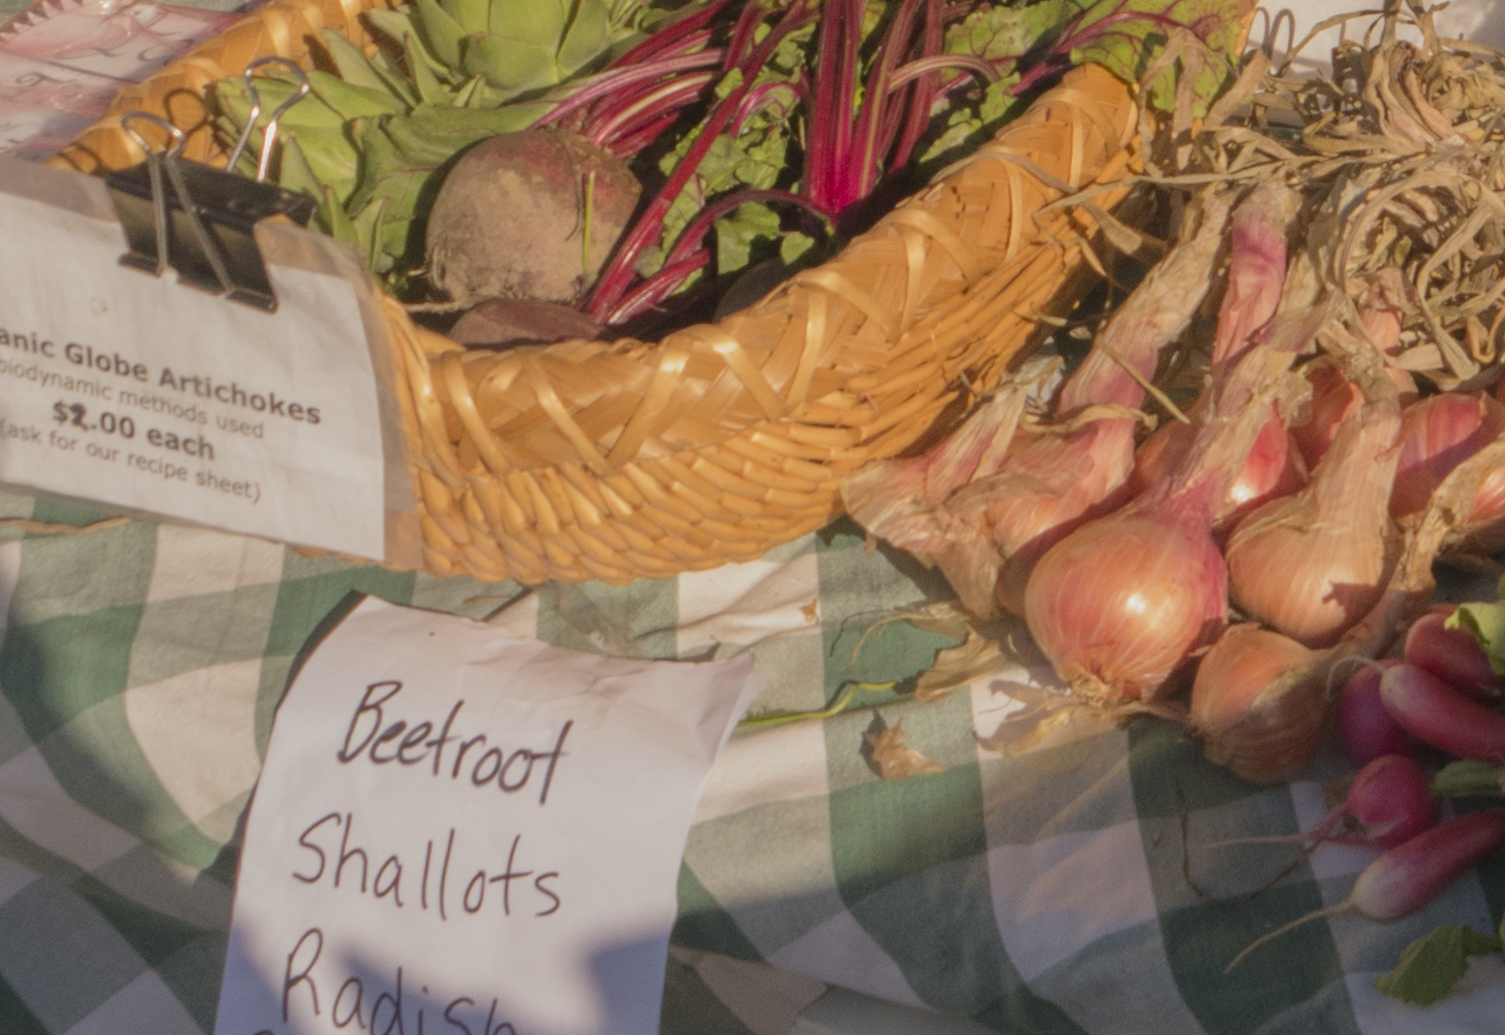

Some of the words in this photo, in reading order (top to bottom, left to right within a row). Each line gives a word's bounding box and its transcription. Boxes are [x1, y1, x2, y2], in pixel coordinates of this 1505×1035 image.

[64, 342, 150, 382] Globe
[158, 366, 322, 425] Artichokes
[118, 390, 209, 425] methods
[216, 413, 265, 440] used
[0, 417, 43, 447] (ask
[49, 430, 79, 452] for
[84, 442, 120, 464] our
[127, 453, 189, 483] recipe
[195, 469, 263, 504] sheet)
[52, 399, 136, 439] $2.00
[146, 424, 216, 462] each
[337, 679, 576, 807] Beetroot
[292, 811, 562, 922] Shallots
